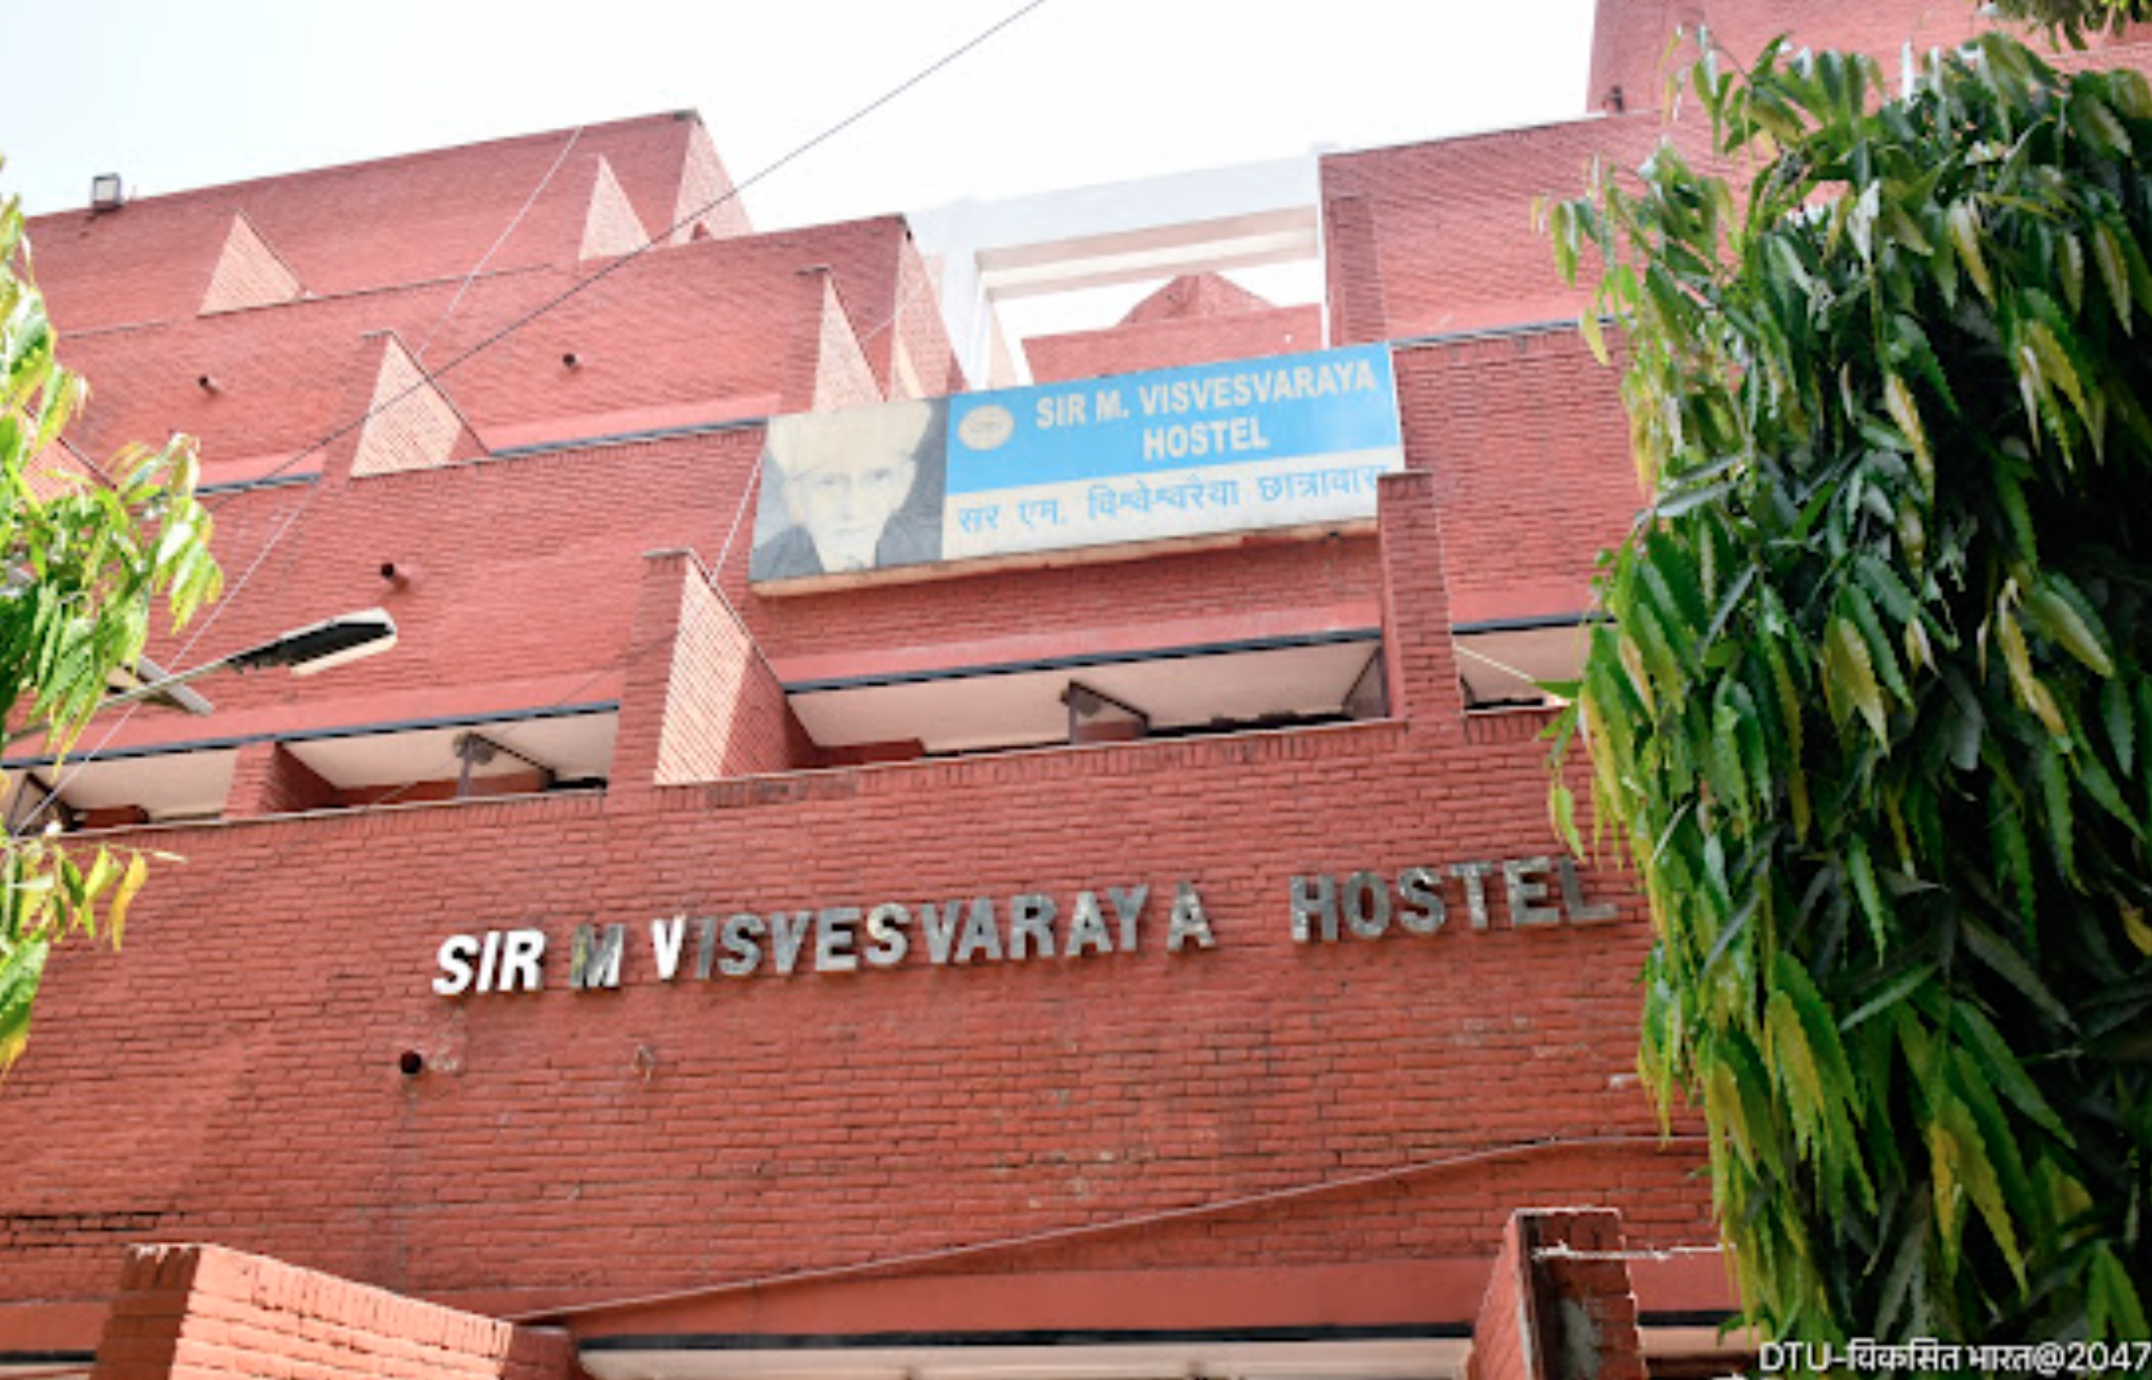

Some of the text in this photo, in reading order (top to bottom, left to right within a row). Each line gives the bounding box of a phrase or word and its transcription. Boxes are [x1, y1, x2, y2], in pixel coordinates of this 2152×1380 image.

[1035, 358, 1377, 430] SIR M. VISVESVARAYA
[1142, 416, 1269, 461] HOSTEL
[957, 504, 1000, 532] सर
[1017, 498, 1066, 528] एम.
[432, 928, 546, 995] SIR
[568, 922, 624, 988] M
[1289, 855, 1618, 943] HOSTEL
